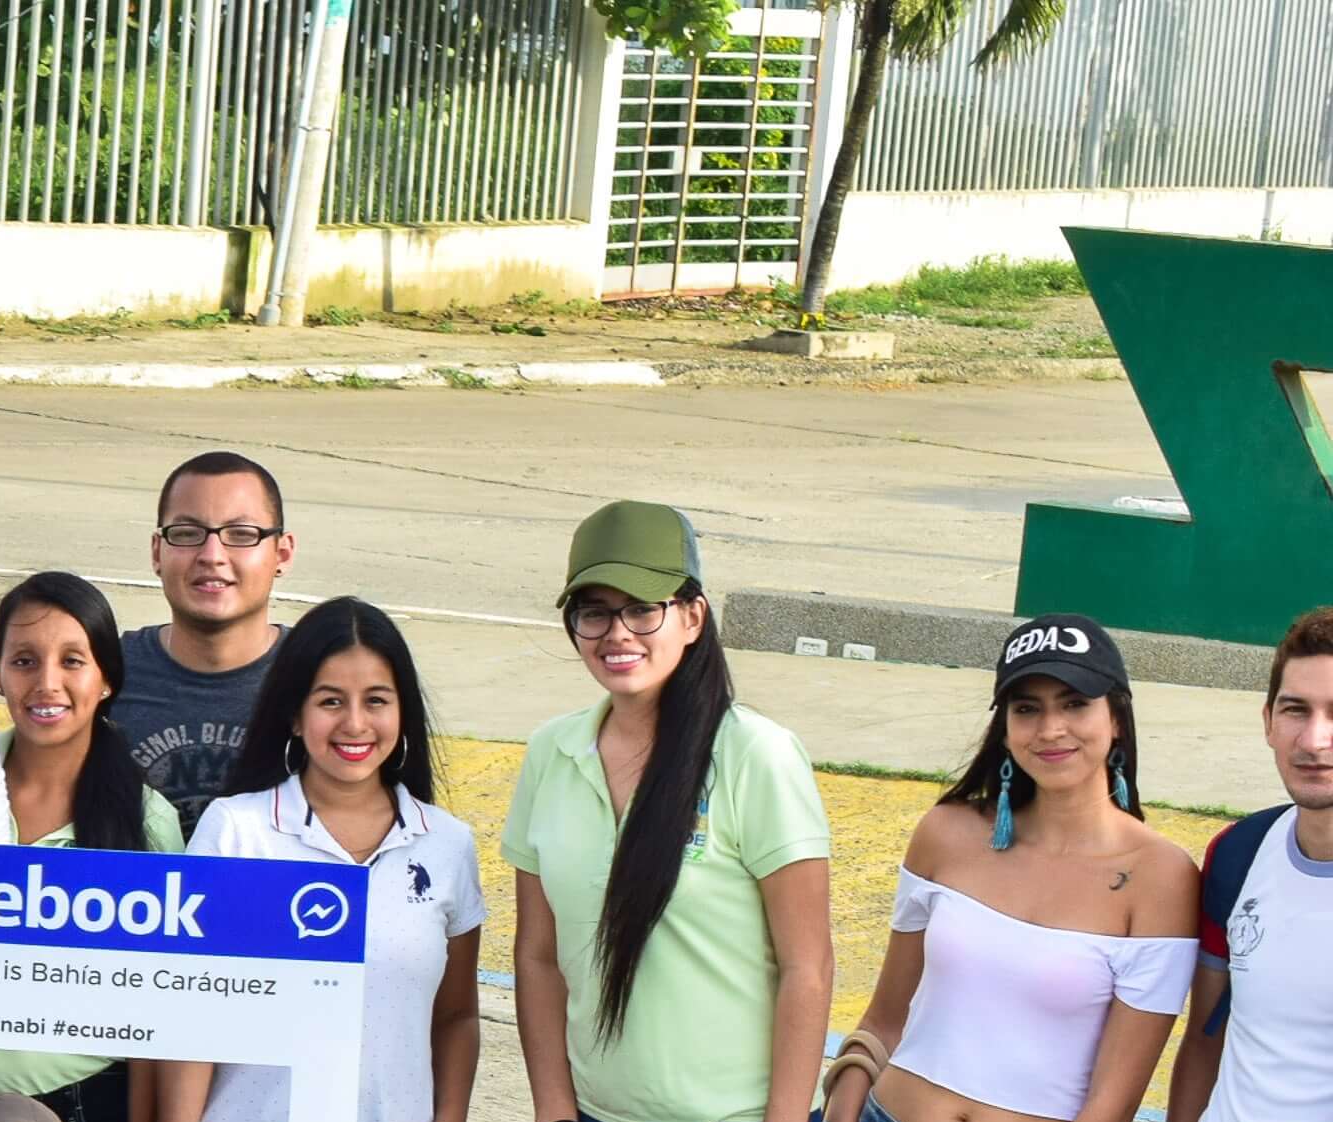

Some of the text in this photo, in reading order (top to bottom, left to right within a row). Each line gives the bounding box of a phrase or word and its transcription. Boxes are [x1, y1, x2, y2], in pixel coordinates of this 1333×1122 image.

[201, 722, 247, 748] BLU
[4, 960, 22, 980] is
[31, 963, 102, 986] Bahía
[111, 967, 143, 988] de
[153, 970, 277, 997] Caráquez
[53, 1020, 155, 1042] #ecuador
